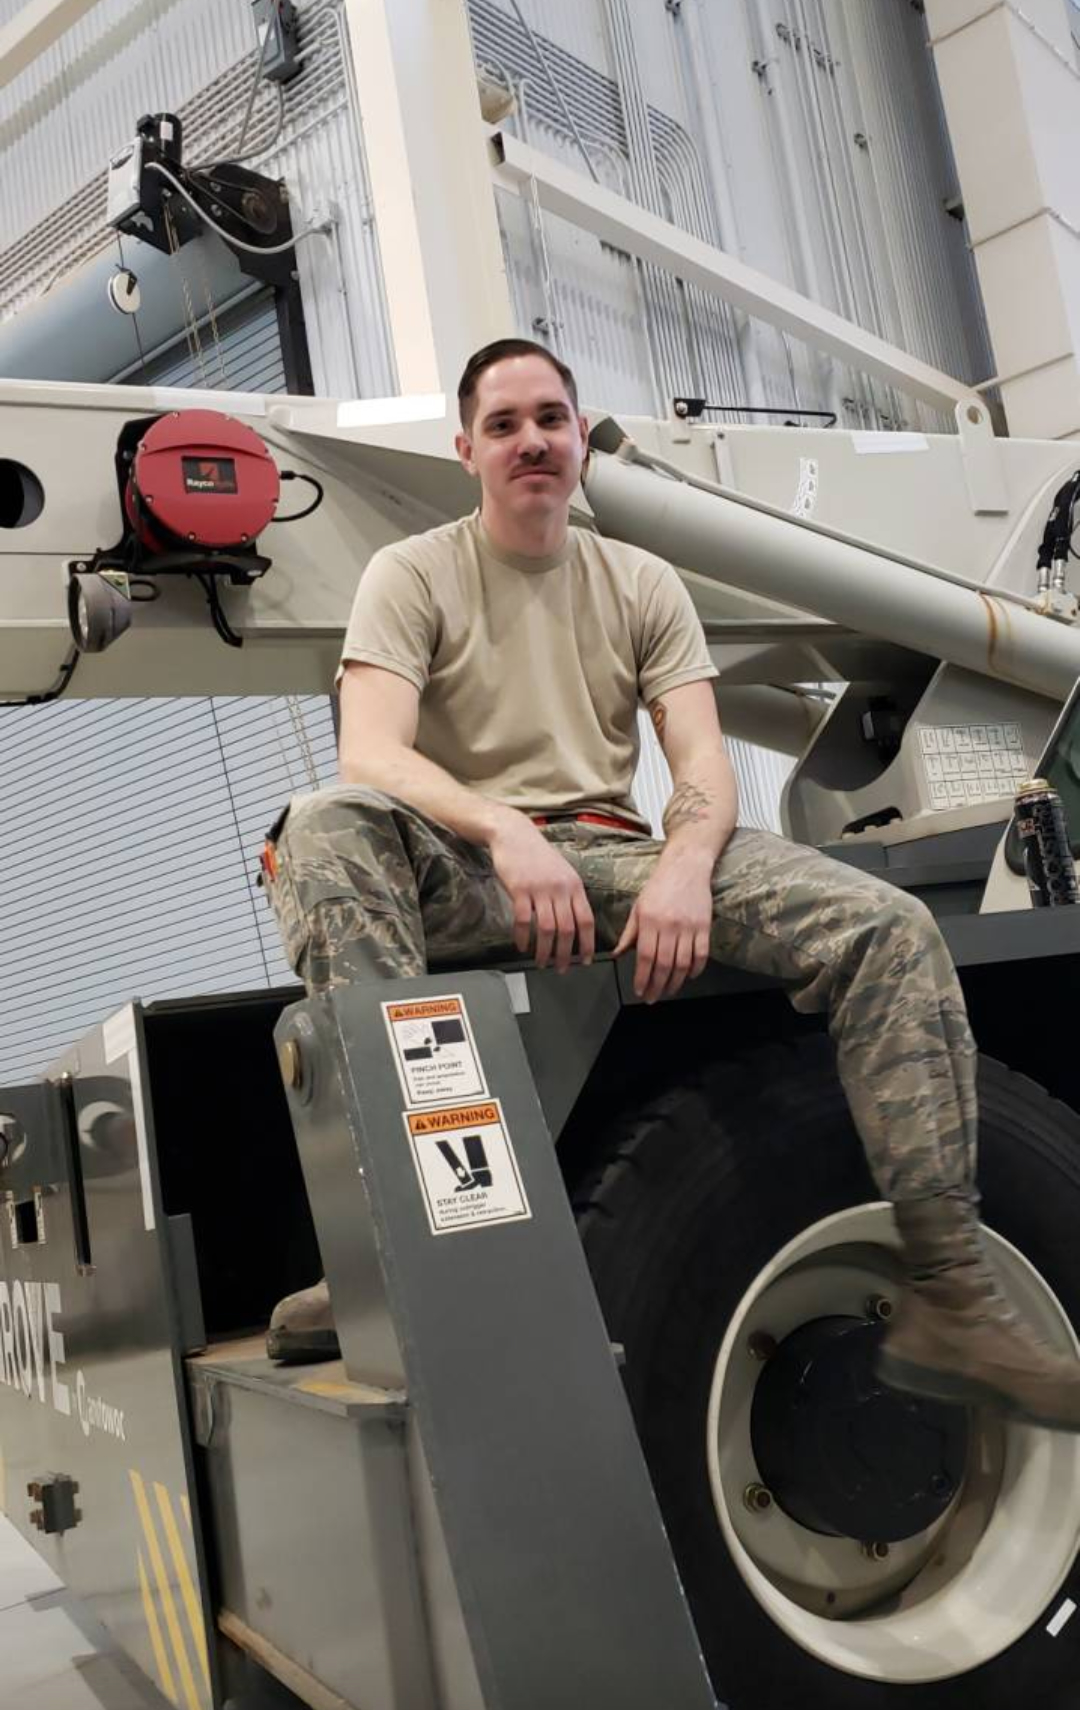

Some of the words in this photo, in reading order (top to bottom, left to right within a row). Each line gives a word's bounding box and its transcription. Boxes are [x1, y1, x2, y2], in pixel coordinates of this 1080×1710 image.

[403, 1002, 457, 1017] WARNING
[411, 1064, 437, 1073] PINCH
[438, 1060, 463, 1071] POINT
[427, 1107, 496, 1129] WARNING
[437, 1197, 457, 1207] STAY
[460, 1192, 488, 1203] CLEAR
[0, 1279, 71, 1416] ROVE
